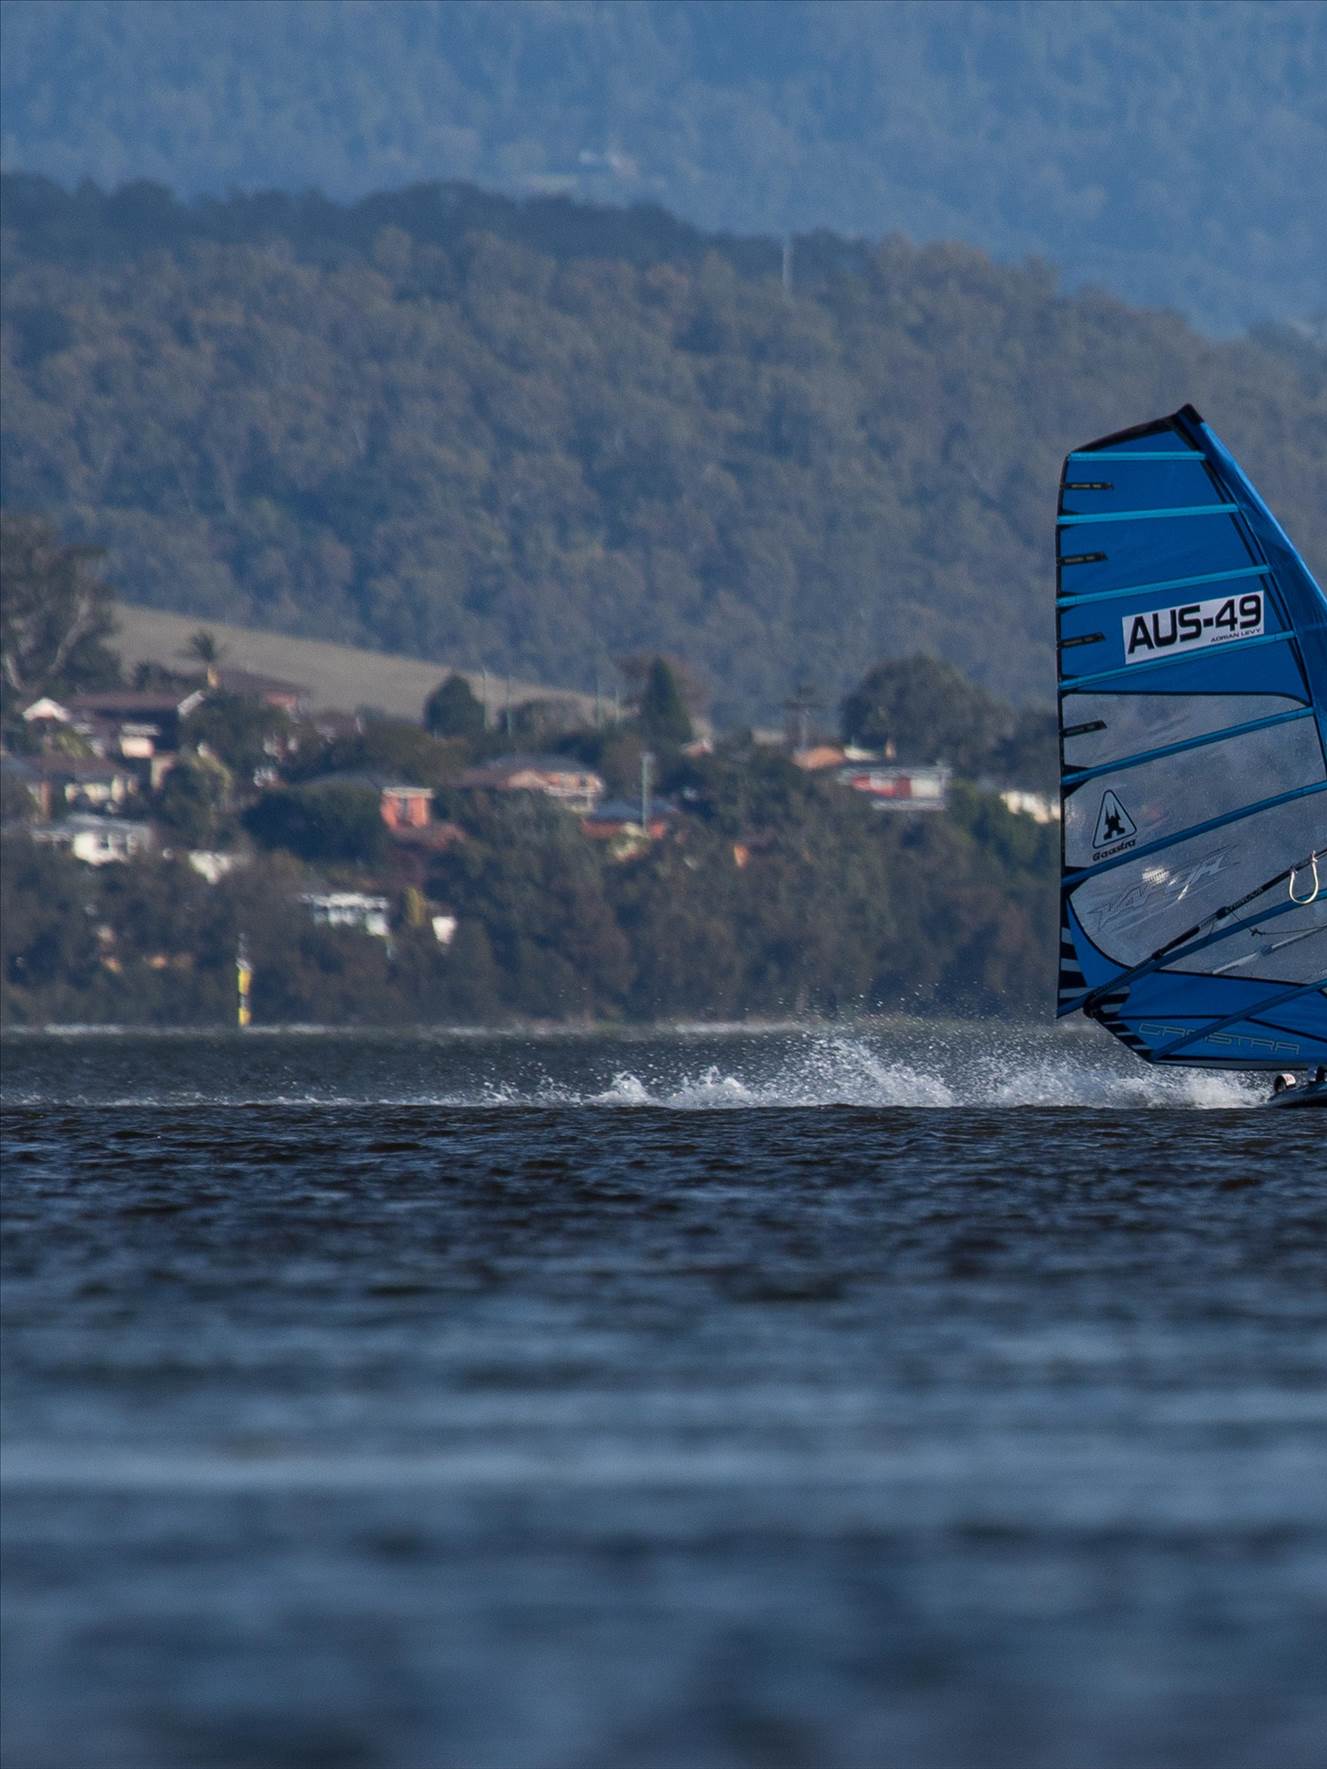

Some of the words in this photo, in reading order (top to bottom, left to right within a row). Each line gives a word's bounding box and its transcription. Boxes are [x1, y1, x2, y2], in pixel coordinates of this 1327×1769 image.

[1127, 594, 1262, 655] AUS-49
[1210, 632, 1240, 643] ADRIAN
[1241, 628, 1261, 637] LEVY
[1092, 839, 1136, 861] Gaastra
[1138, 1023, 1301, 1055] GASTRA
